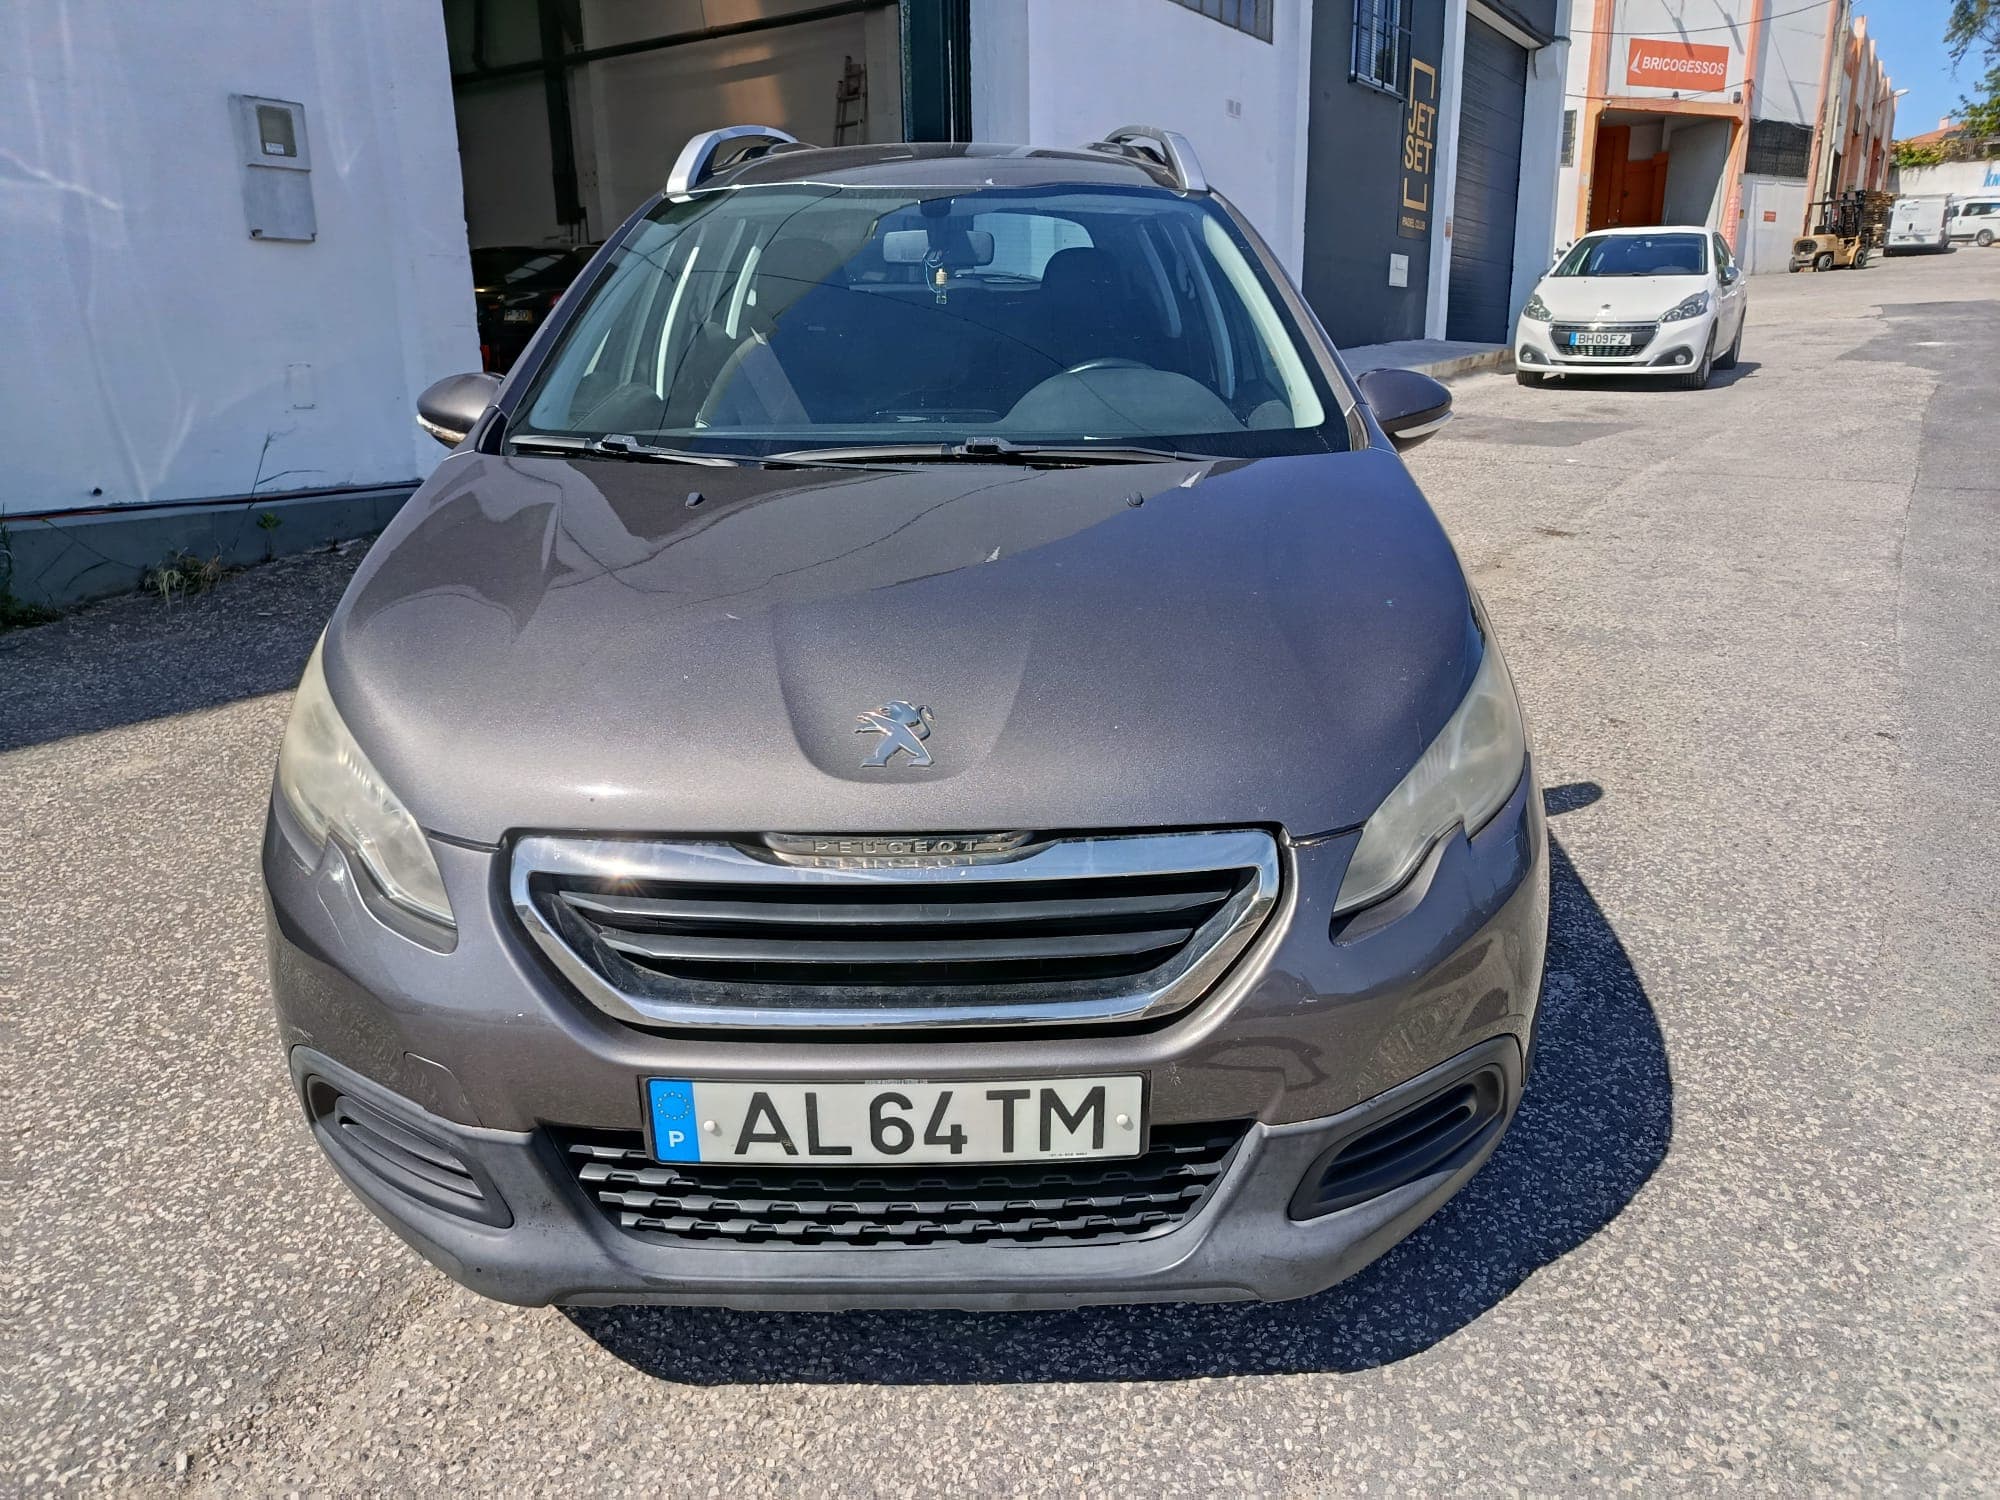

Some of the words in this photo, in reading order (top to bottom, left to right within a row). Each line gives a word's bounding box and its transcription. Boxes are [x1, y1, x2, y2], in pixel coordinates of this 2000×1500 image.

[1642, 56, 1725, 76] BRICOGESSOS
[1408, 100, 1436, 140] JET
[1404, 135, 1433, 175] SET
[813, 839, 978, 854] PEUGEOT
[668, 1130, 685, 1149] P
